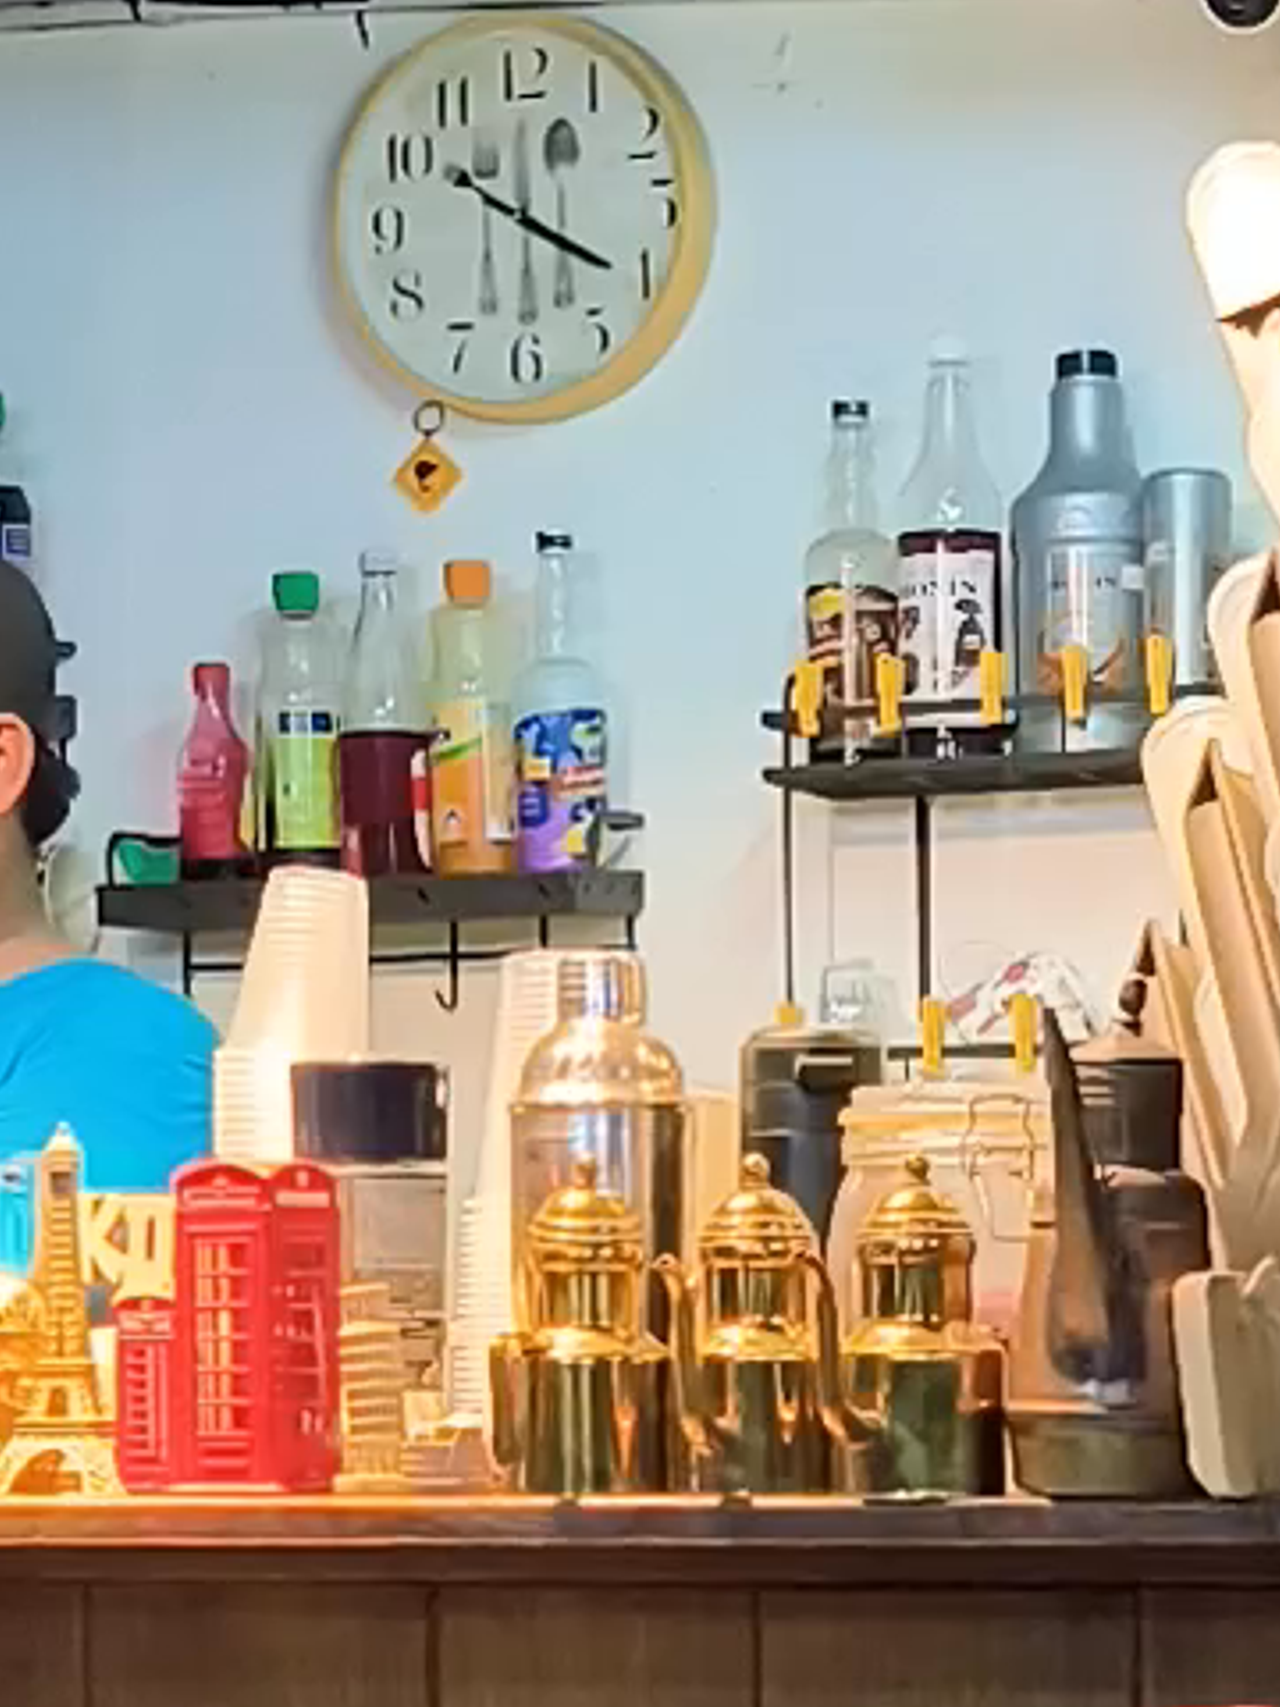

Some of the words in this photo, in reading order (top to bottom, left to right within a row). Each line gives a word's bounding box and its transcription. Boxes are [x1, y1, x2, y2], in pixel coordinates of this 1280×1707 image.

[505, 48, 549, 102] 12
[588, 60, 599, 113] 1
[437, 77, 470, 128] 11
[387, 133, 434, 183] 10
[372, 205, 406, 256] 9
[390, 270, 426, 322] 8
[447, 322, 475, 374] 7
[509, 334, 544, 385] 6
